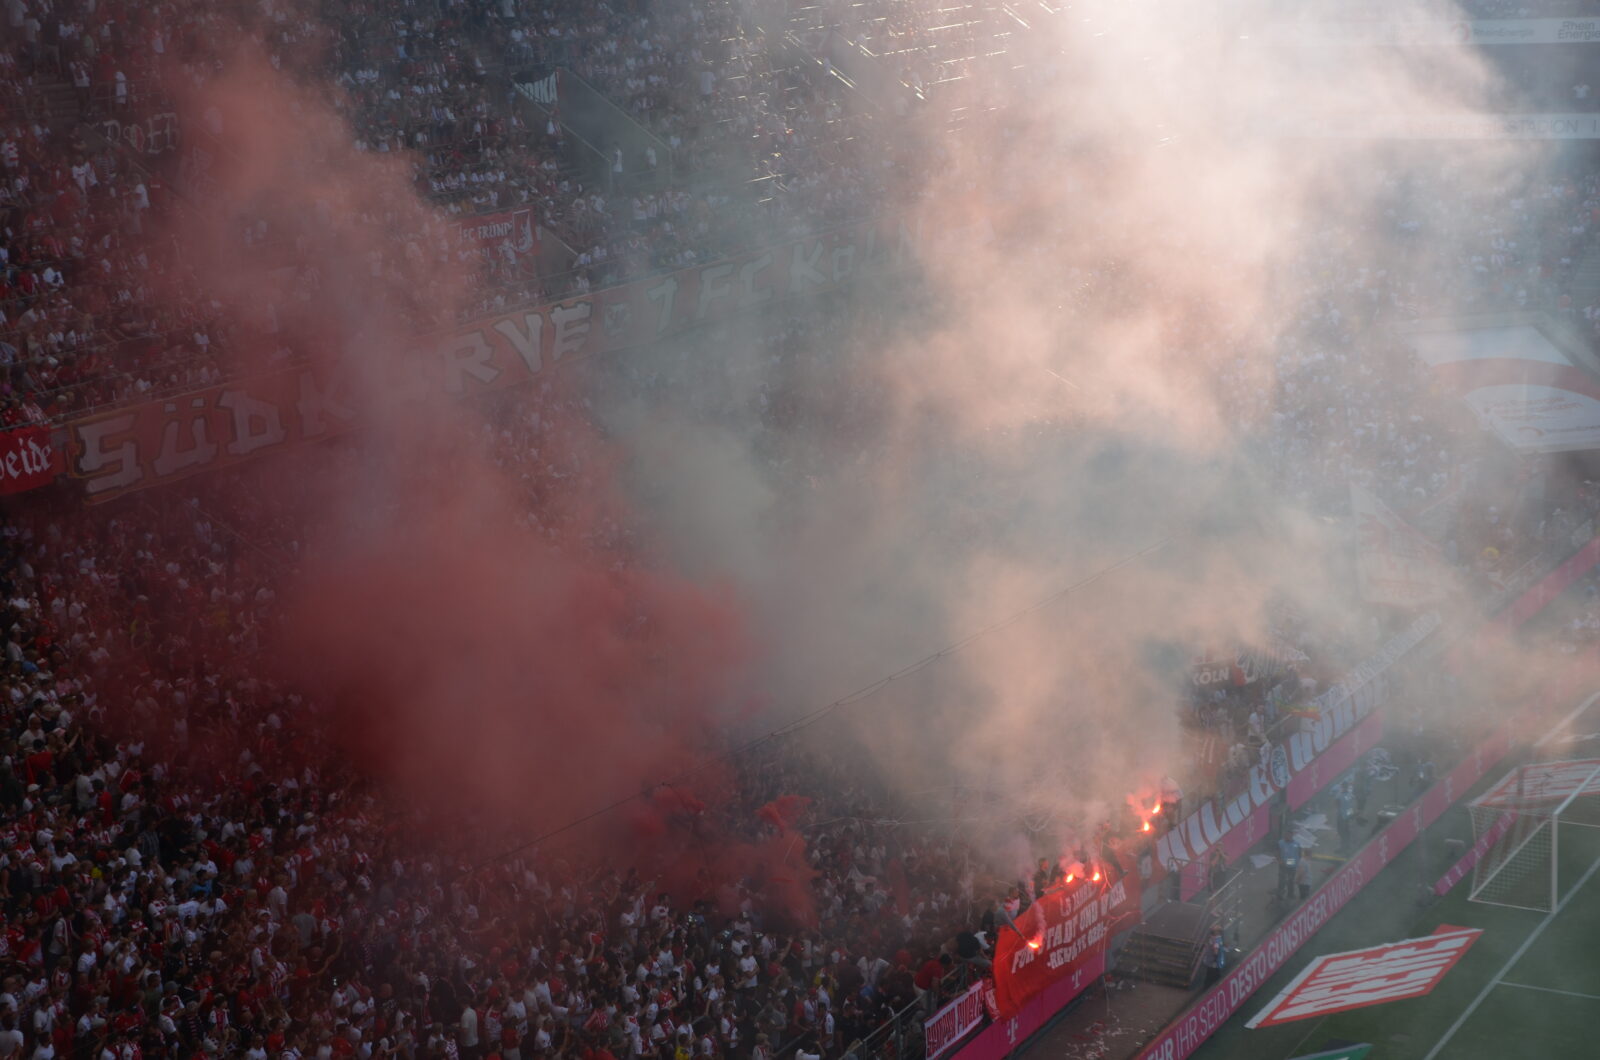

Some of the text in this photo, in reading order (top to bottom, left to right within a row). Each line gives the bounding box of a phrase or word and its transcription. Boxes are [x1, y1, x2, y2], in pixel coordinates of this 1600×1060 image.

[0, 437, 52, 480] eide
[1176, 1016, 1199, 1059] IHR
[1200, 990, 1229, 1037] SEID,
[1230, 951, 1267, 1008] DESTO
[1266, 890, 1328, 970] GÜNSTIGER
